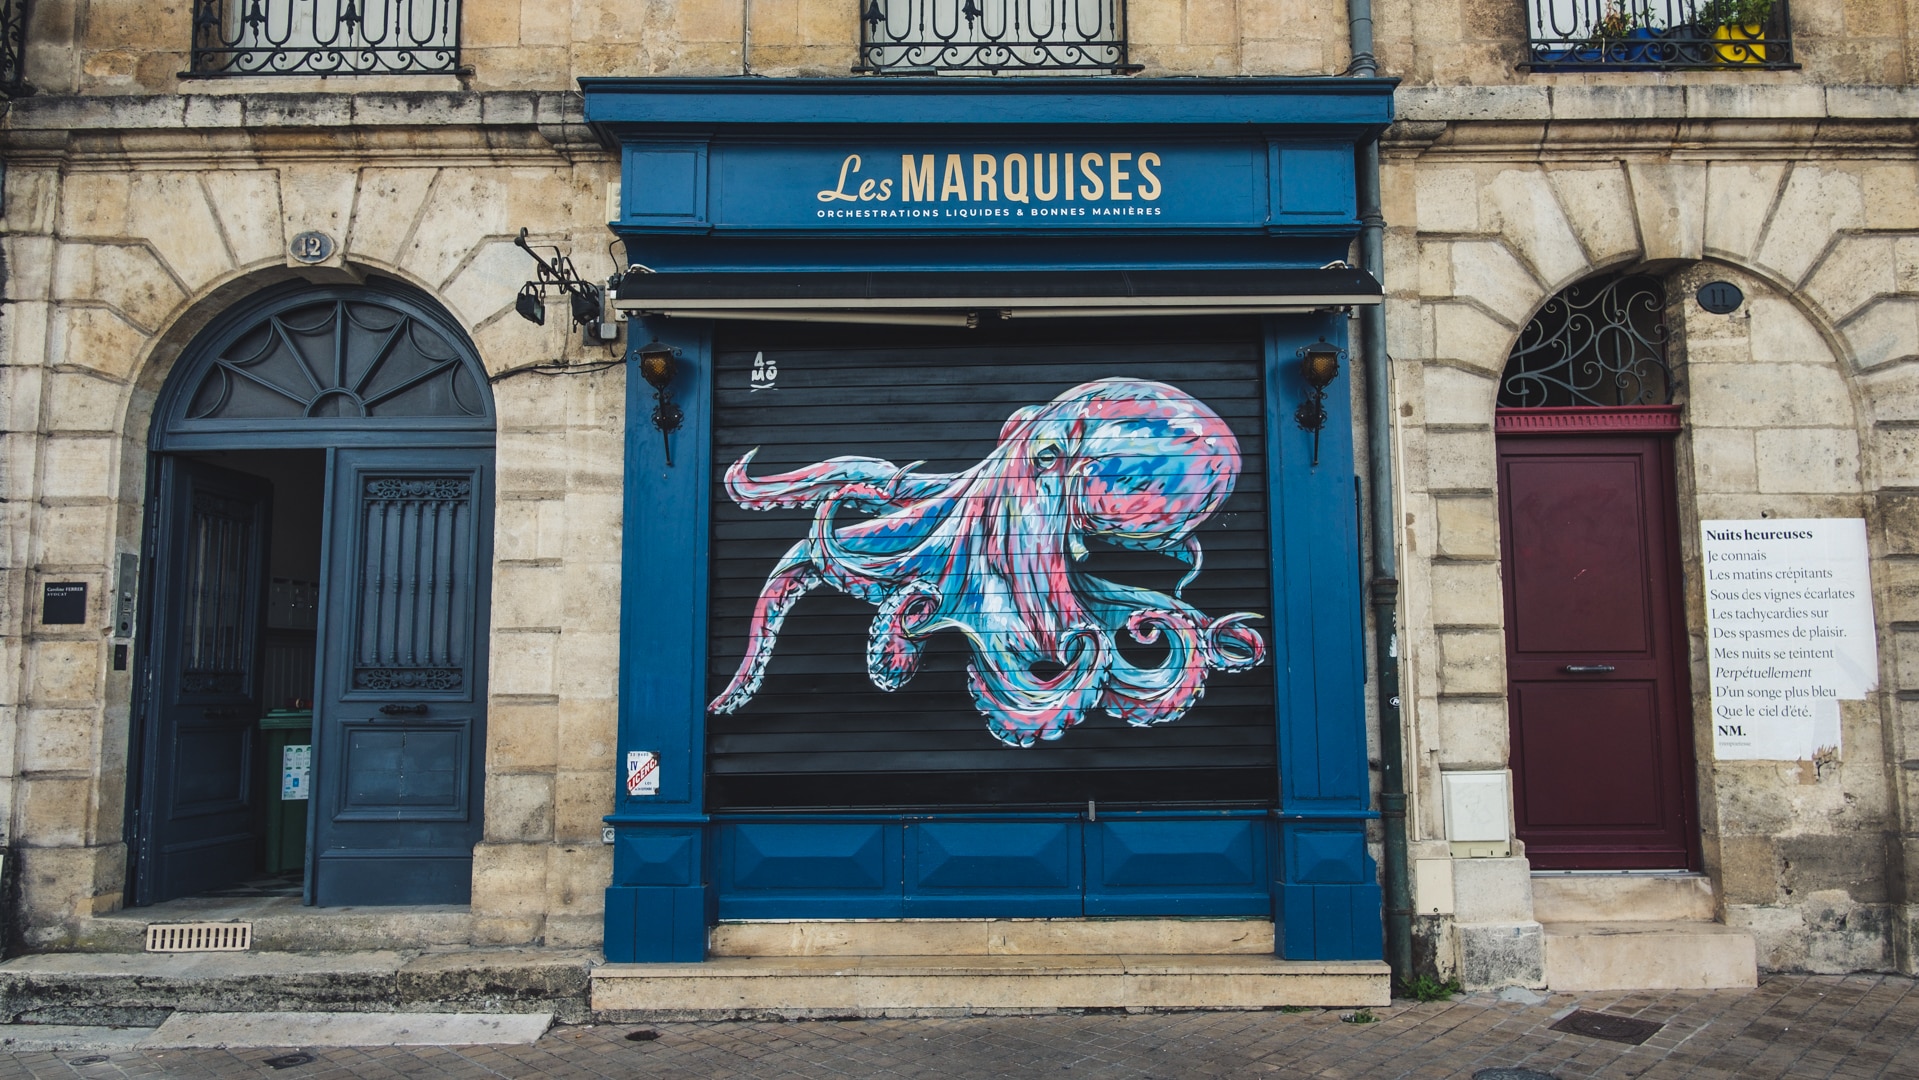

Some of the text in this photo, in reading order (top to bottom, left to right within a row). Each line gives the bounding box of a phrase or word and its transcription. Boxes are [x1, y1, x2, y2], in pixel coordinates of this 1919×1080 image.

[816, 152, 1162, 204] Les MARQUISES
[816, 205, 1161, 218] ORCHESTRATIONS LIQUIDES & BONNES MANIÈRES
[300, 237, 321, 256] 12
[1711, 288, 1729, 307] 11
[1707, 529, 1812, 540] Nuits heureuses
[1708, 550, 1766, 563] Je connais
[1710, 567, 1832, 583] Les matins crépitants
[1711, 588, 1855, 603] Sous des vignes écarlates
[1712, 607, 1828, 622] Les tachycardies sur
[1714, 626, 1846, 641] Des spasmes de plaisir.
[1715, 648, 1833, 659] Mes nuits se teintent
[1716, 667, 1811, 681] Perpétuellement
[1747, 690, 1781, 700] songe
[1785, 686, 1809, 701] plus
[1812, 685, 1836, 697] bleu
[1717, 706, 1742, 718] Que
[1746, 705, 1754, 716] le
[1759, 705, 1778, 716] ciel
[1719, 726, 1746, 736] NM.
